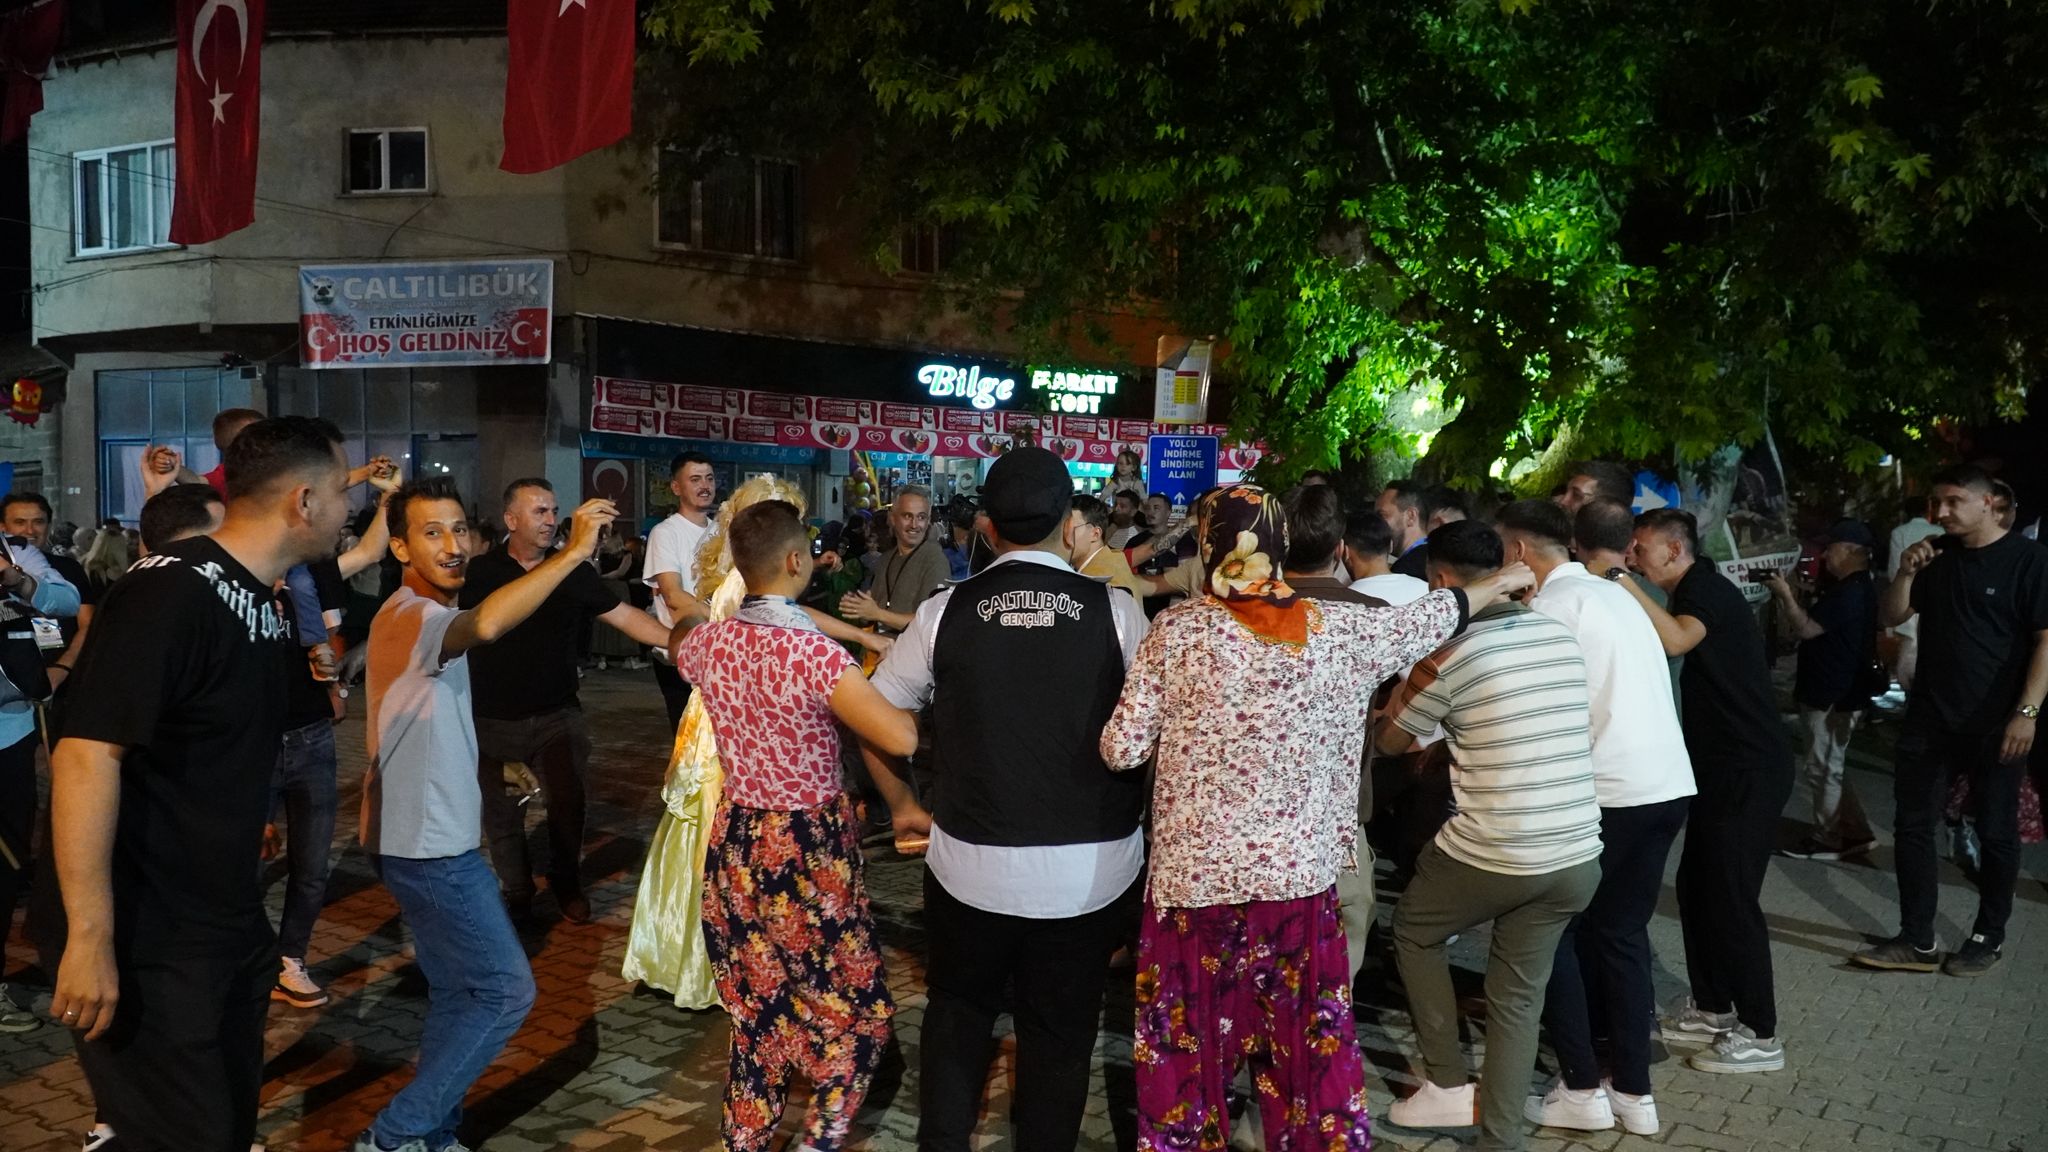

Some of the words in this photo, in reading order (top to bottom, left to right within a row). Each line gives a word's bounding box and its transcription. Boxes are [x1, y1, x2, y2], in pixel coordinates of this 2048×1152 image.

[369, 311, 478, 330] ETKİNLİĞİMİZE
[340, 334, 391, 358] HOŞ
[400, 328, 508, 353] GELDİNİZ
[918, 364, 1015, 410] Bilge
[1168, 439, 1198, 448] YOLCU
[1163, 448, 1202, 458] İNDİRME
[1160, 459, 1205, 469] BİNDİRME
[1168, 470, 1196, 479] ALANI
[977, 590, 1084, 622] ÇALTILIBÜK
[1000, 611, 1055, 628] GENÇLİĞİ
